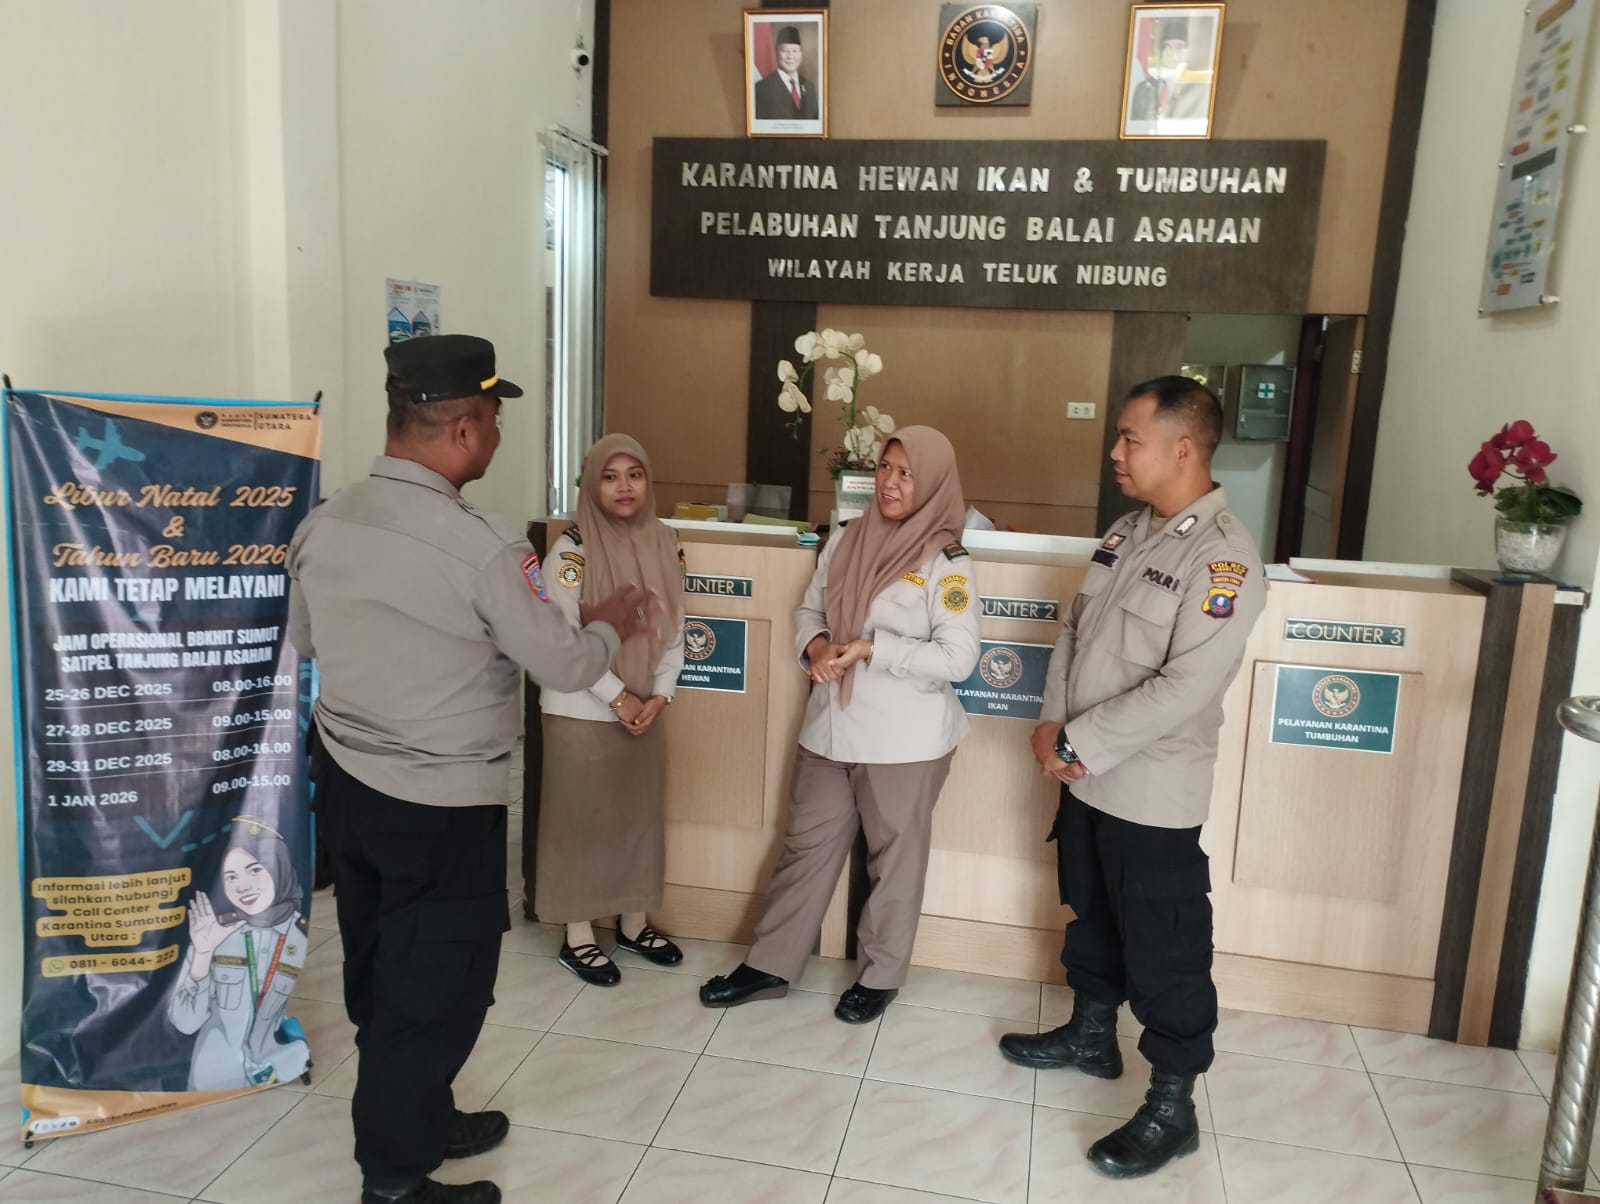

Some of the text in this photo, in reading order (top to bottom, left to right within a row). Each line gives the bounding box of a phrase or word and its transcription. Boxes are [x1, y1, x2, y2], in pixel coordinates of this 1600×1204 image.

[943, 60, 1025, 98] INDONESIA
[681, 162, 1287, 194] KARANTINA HEWAN IKAN & TUMBUHAN
[700, 211, 1262, 244] PELABUHAN TANJUNG BALAI ASAHAN
[768, 258, 1167, 287] WILAYAH KERJA TELUK NIBUNG
[259, 412, 312, 421] SUMATERA
[259, 422, 292, 430] UTARA
[43, 481, 298, 511] Libur Natal 2025
[162, 515, 185, 538] &
[52, 543, 288, 568] Tahun Baru 2026
[49, 574, 286, 603] KAMI TETAP MELAYANI
[681, 577, 749, 595] UNTER 1
[1141, 567, 1180, 592] POLRI
[982, 600, 1038, 619] UNTER
[1044, 603, 1057, 619] 2
[53, 634, 88, 652] JAM
[90, 632, 184, 650] OPERASIONAL
[236, 626, 280, 645] SUMUT
[1292, 622, 1401, 645] COUNTER 3
[61, 646, 273, 672] SATPEL TANJUNG BALAI ASAHAN
[697, 664, 741, 675] KARANTINA
[45, 674, 293, 701] 25-26 DEC 2025 08.00-16.00
[681, 674, 710, 682] HEWAN
[955, 688, 999, 699] ELAYANAN
[987, 702, 1009, 711] IKAN
[45, 709, 293, 737] 27-28 DEC 2025 09.00-15.00
[1278, 717, 1389, 735] PELAYANAN KARANTINA
[1304, 731, 1359, 743] TUMBUHAN
[46, 742, 292, 772] 29-31 DEC 2025 08.00-16.00
[47, 774, 292, 807] 1 JAN 2026 09.00-15.00
[38, 873, 187, 892] Informasi lebih lanjut
[52, 887, 174, 905] silahkan hubungi
[72, 904, 150, 917] Call Center
[41, 912, 182, 931] Karantina Sumatera
[90, 932, 128, 942] Utara
[69, 959, 97, 969] 0811
